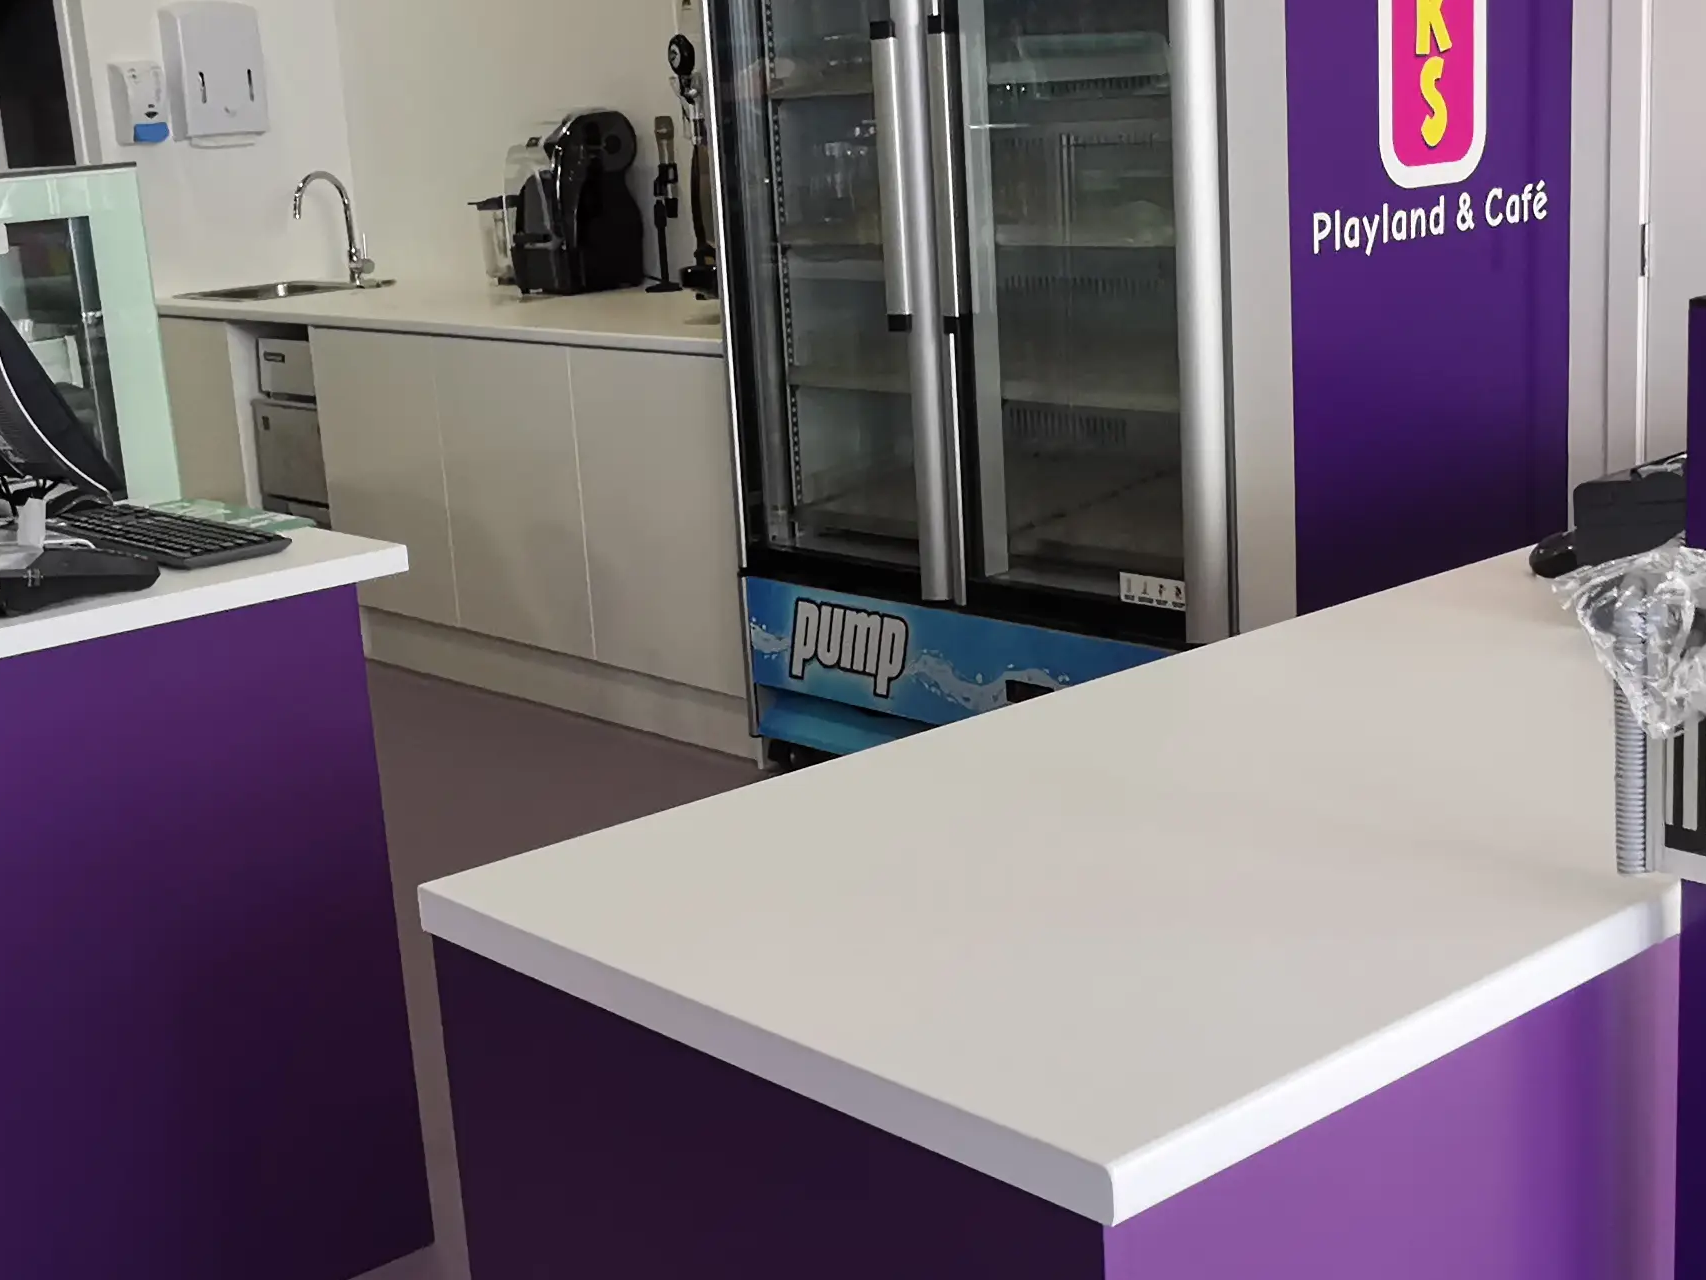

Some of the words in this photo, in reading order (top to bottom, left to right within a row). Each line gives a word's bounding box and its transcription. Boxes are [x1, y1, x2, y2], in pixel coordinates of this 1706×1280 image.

[1312, 194, 1445, 256] Playland
[1456, 191, 1475, 232] &
[1484, 179, 1548, 227] Café
[791, 599, 906, 696] pump
